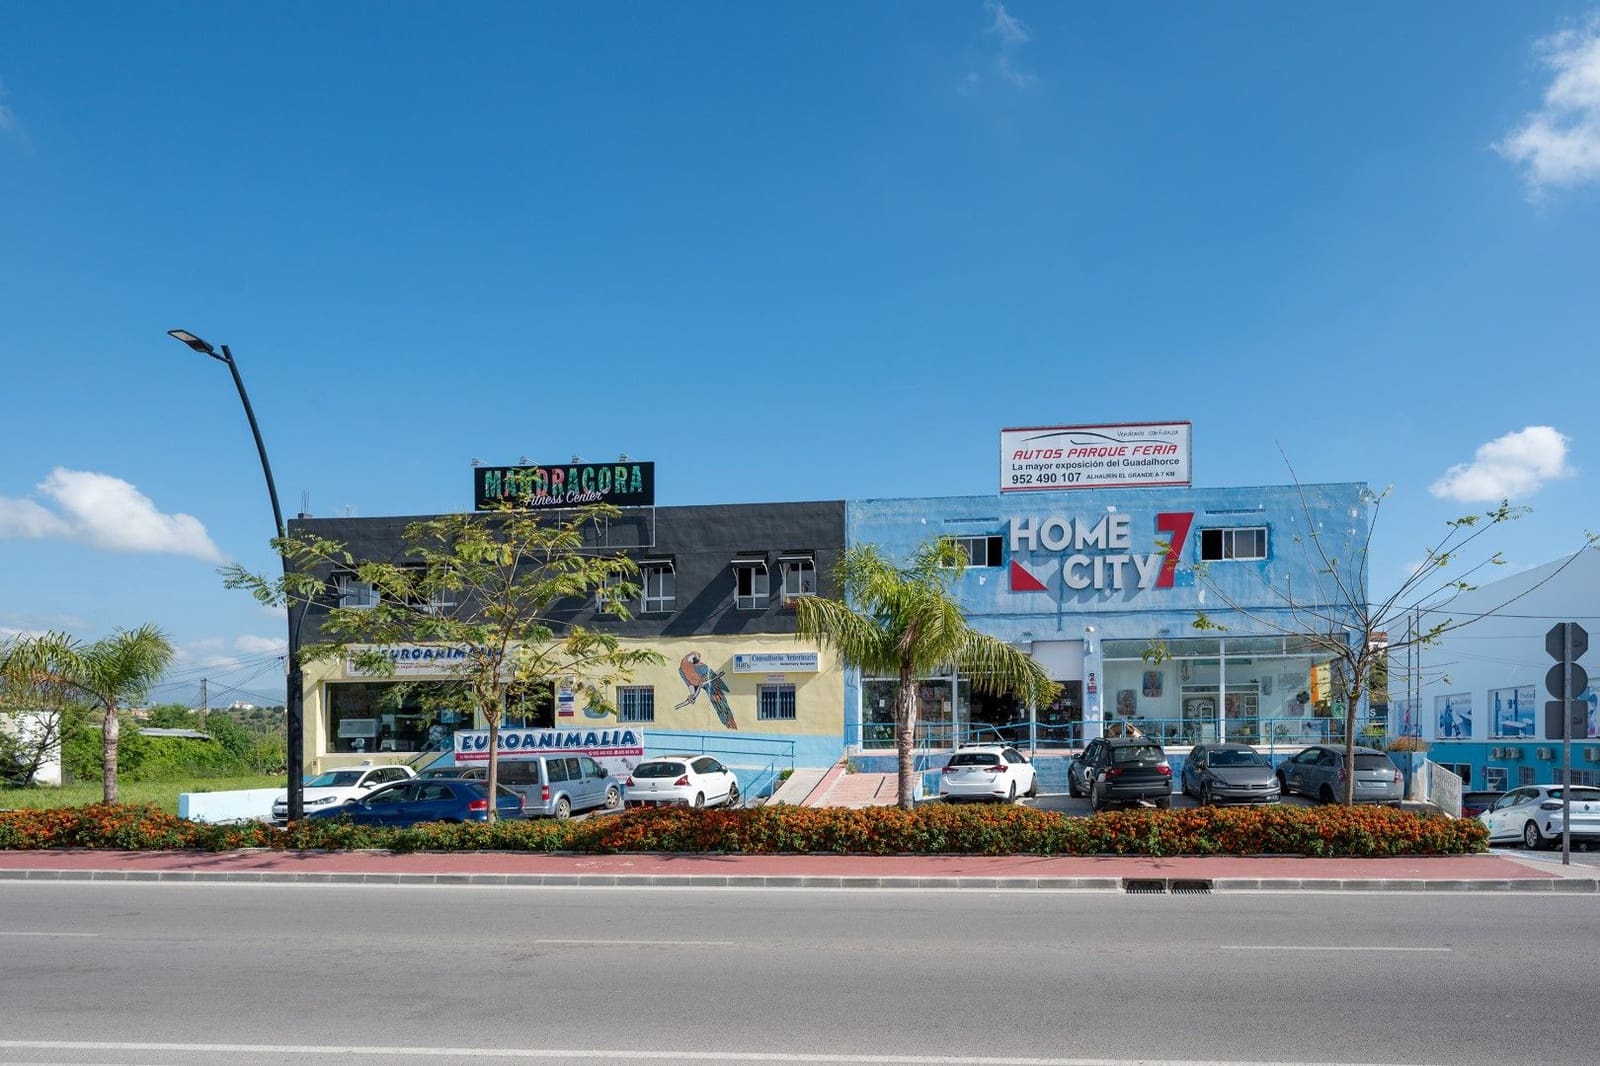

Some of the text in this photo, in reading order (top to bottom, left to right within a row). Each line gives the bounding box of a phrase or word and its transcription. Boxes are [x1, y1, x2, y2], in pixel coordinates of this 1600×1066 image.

[1013, 444, 1177, 460] AUTOS PARQUE FERIA
[1012, 457, 1180, 472] La mayor exposición del Guadalhorce
[1012, 474, 1033, 484] 952
[1036, 473, 1057, 483] 490
[1061, 472, 1081, 482] 107
[1128, 471, 1154, 479] GRANDE
[525, 491, 603, 507] Fitness Center
[1010, 514, 1130, 551] HOME
[1157, 512, 1195, 588] 7
[1062, 554, 1159, 589] CITY
